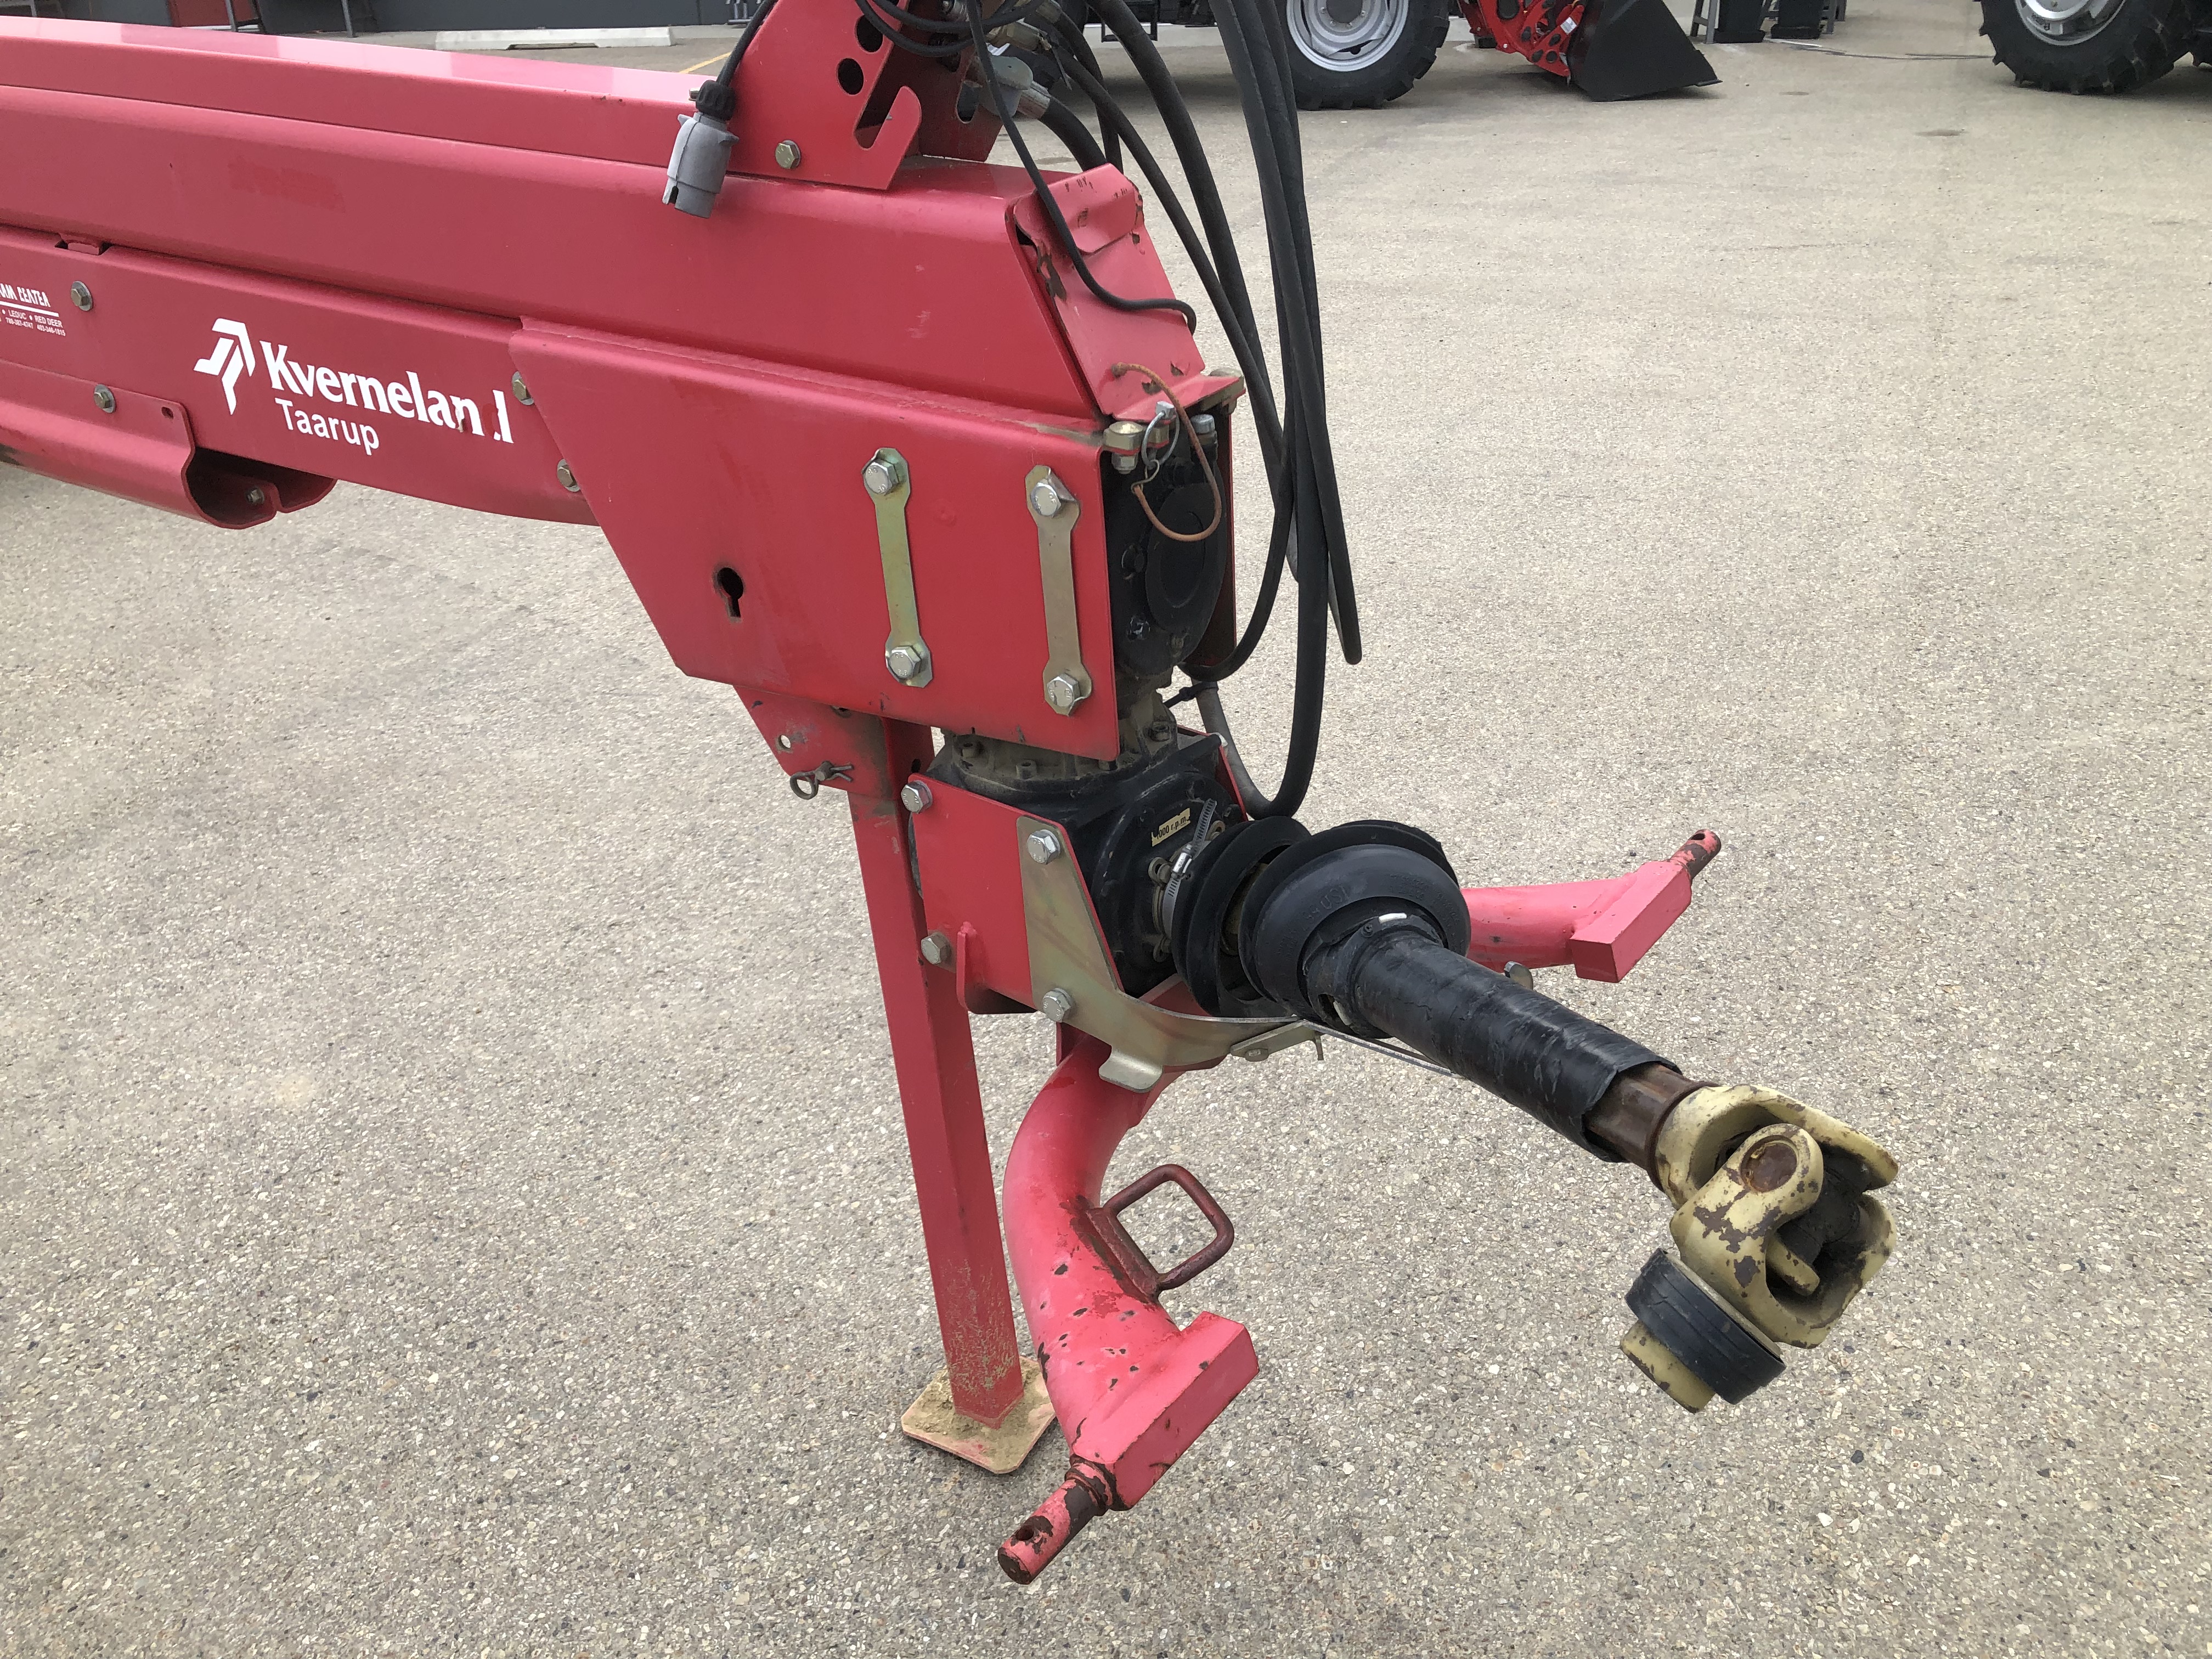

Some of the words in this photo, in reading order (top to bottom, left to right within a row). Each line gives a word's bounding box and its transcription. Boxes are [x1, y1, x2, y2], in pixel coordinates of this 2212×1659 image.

[8, 309, 27, 319] LEDUC
[34, 315, 46, 325] RED
[47, 318, 63, 328] DEER
[275, 397, 379, 456] Taarup
